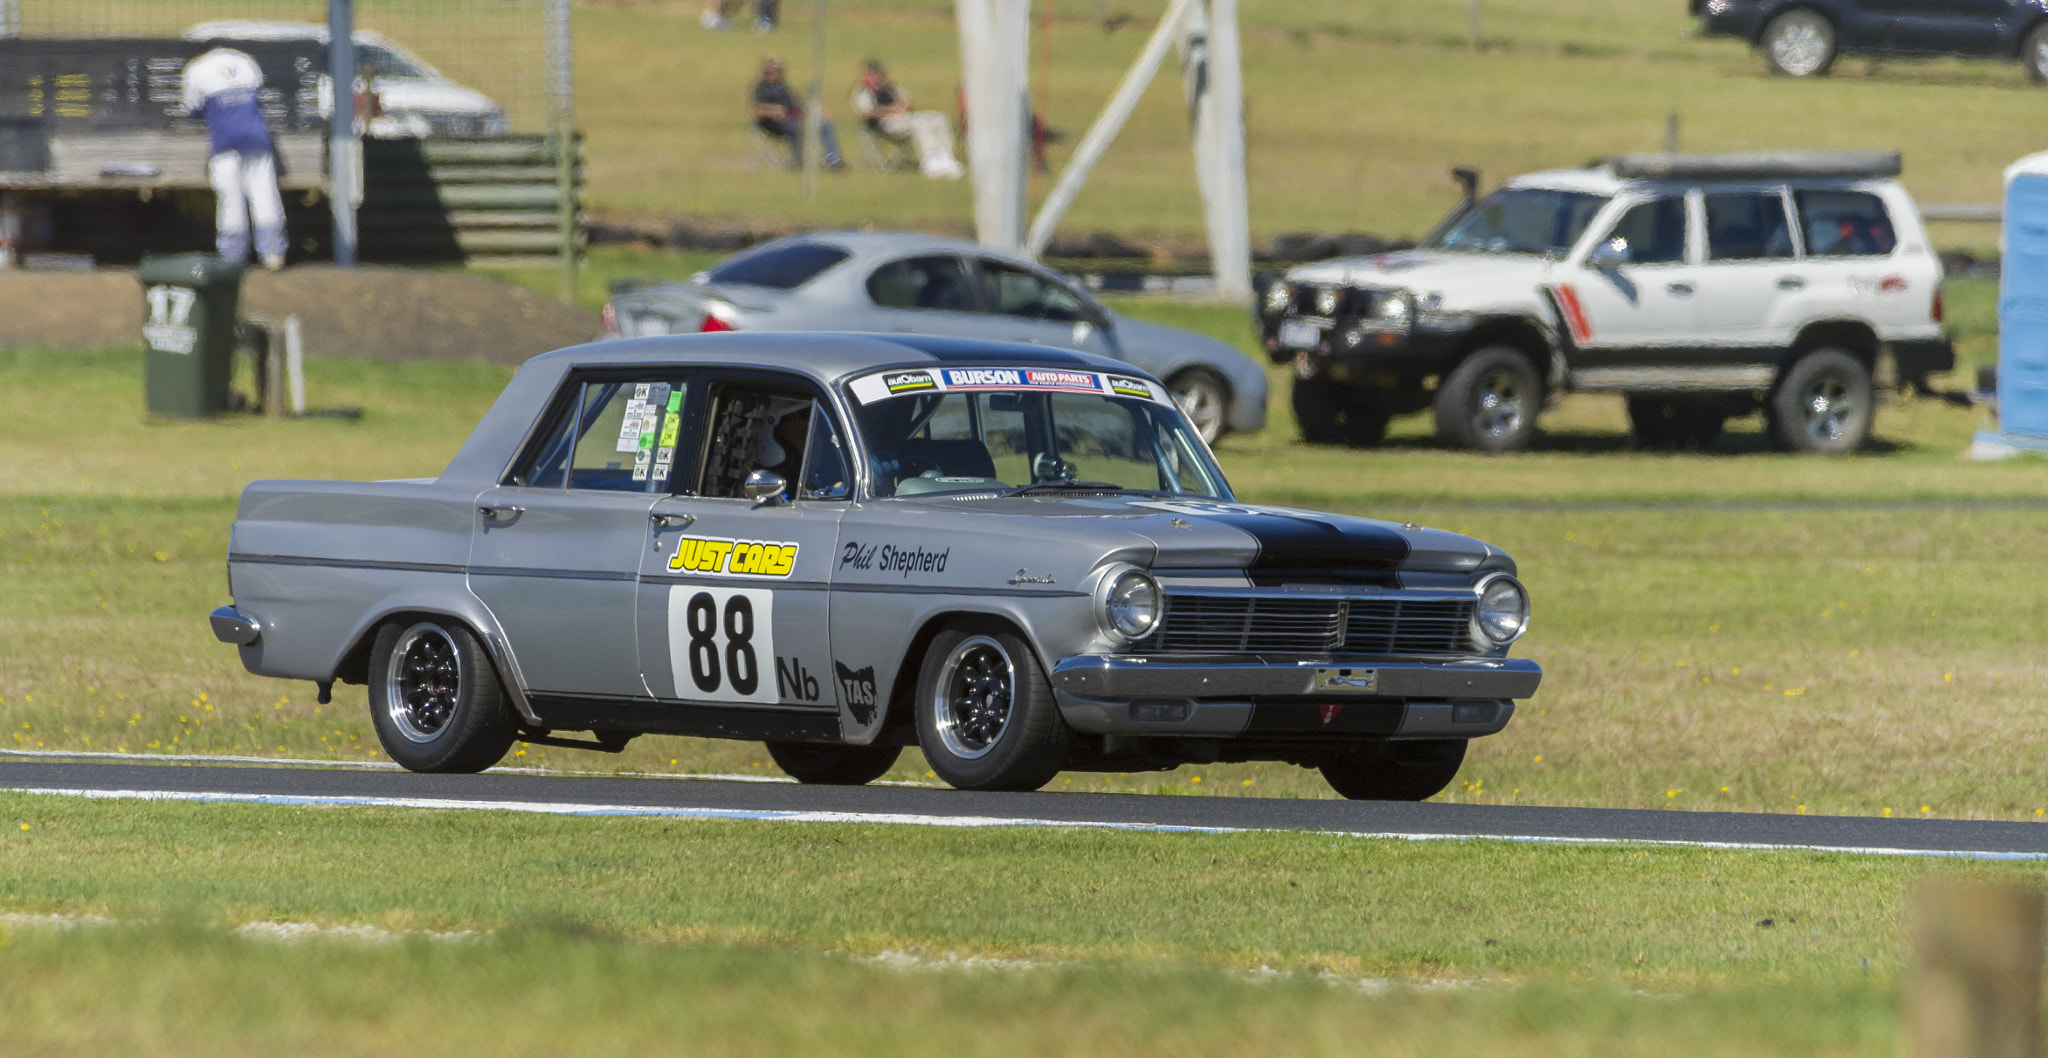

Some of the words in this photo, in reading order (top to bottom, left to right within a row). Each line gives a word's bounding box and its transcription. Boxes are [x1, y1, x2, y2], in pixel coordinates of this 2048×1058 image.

[147, 284, 196, 325] 17
[949, 370, 1021, 385] BURSON
[1032, 372, 1058, 382] AUTO
[1058, 373, 1090, 384] PARTS
[669, 537, 733, 572] JUST
[729, 541, 798, 575] CARS
[839, 541, 877, 571] Phil
[879, 543, 950, 578] Shepherd
[686, 591, 759, 696] 88
[776, 656, 820, 702] Nb
[844, 678, 875, 707] TAS
